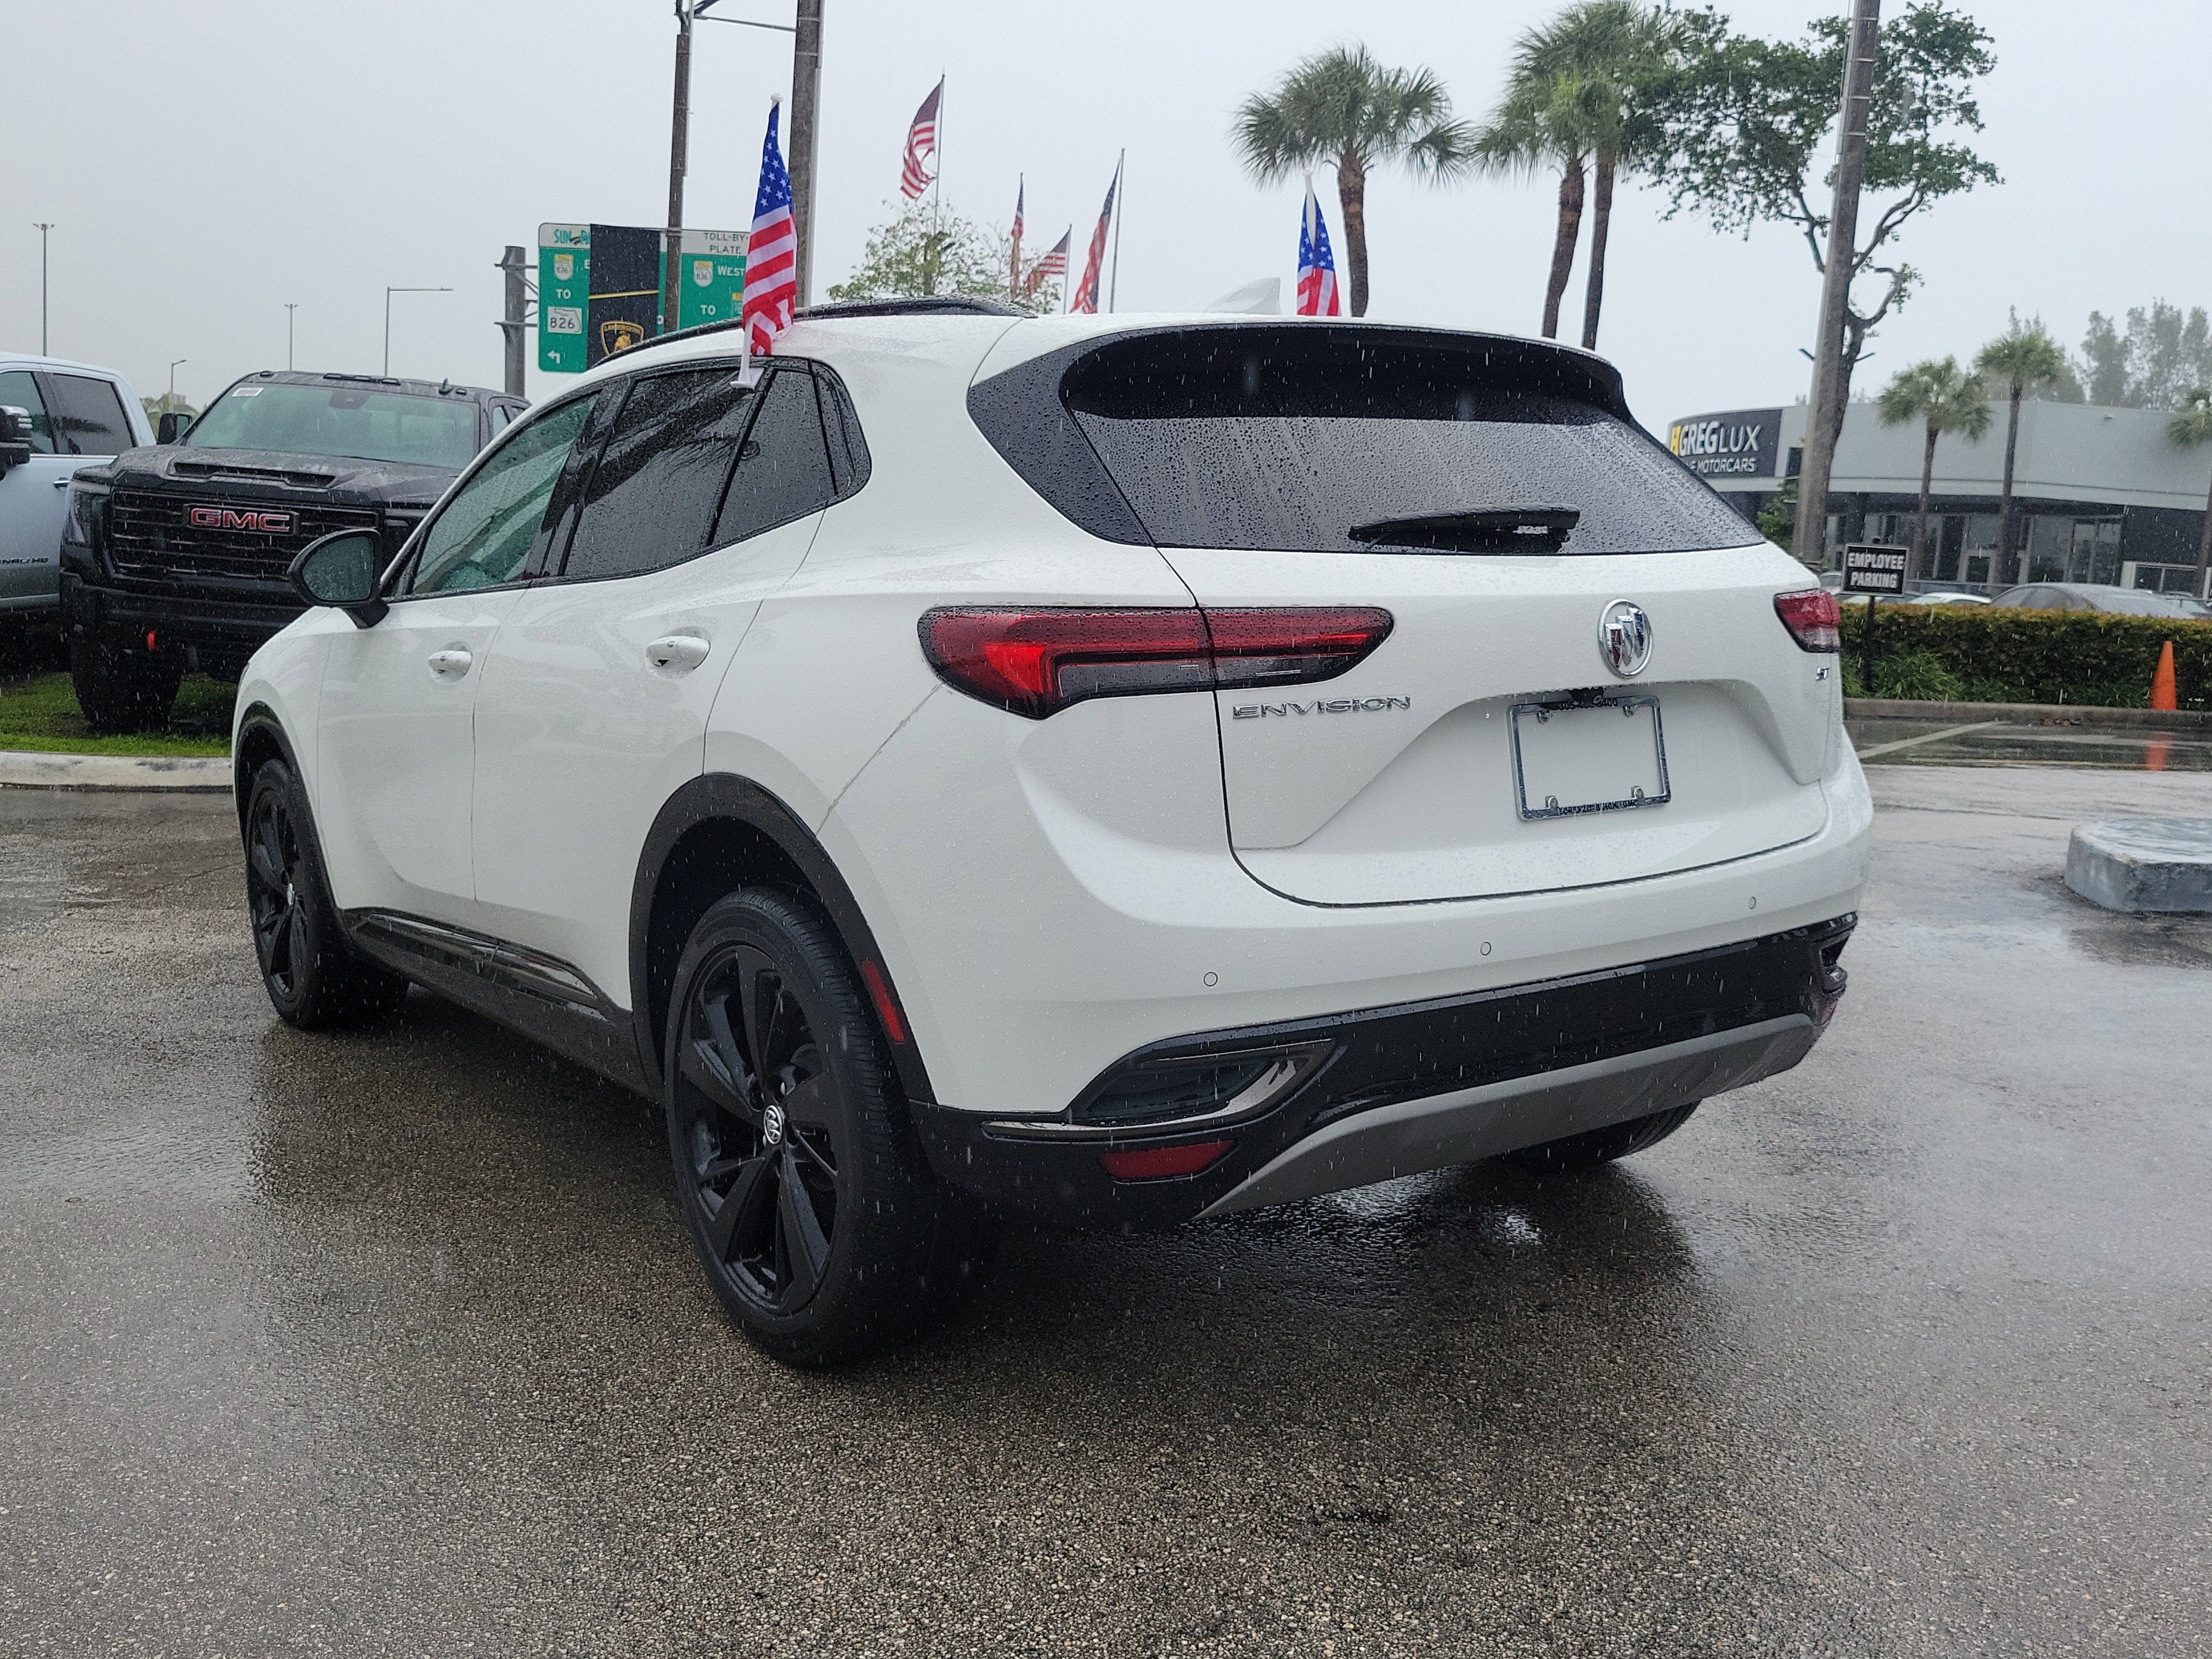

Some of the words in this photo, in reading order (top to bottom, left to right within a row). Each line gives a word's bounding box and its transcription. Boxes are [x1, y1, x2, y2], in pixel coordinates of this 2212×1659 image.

[710, 245, 742, 255] PLATE
[717, 264, 746, 276] WEST
[555, 288, 572, 300] TO
[700, 304, 716, 316] TO
[550, 317, 575, 329] 826
[1697, 457, 1757, 473] MOTORCARS
[190, 508, 290, 532] GMC
[1847, 552, 1905, 570] EMPLOYEE
[1850, 571, 1898, 589] PARKING
[1232, 695, 1411, 720] ENVISION
